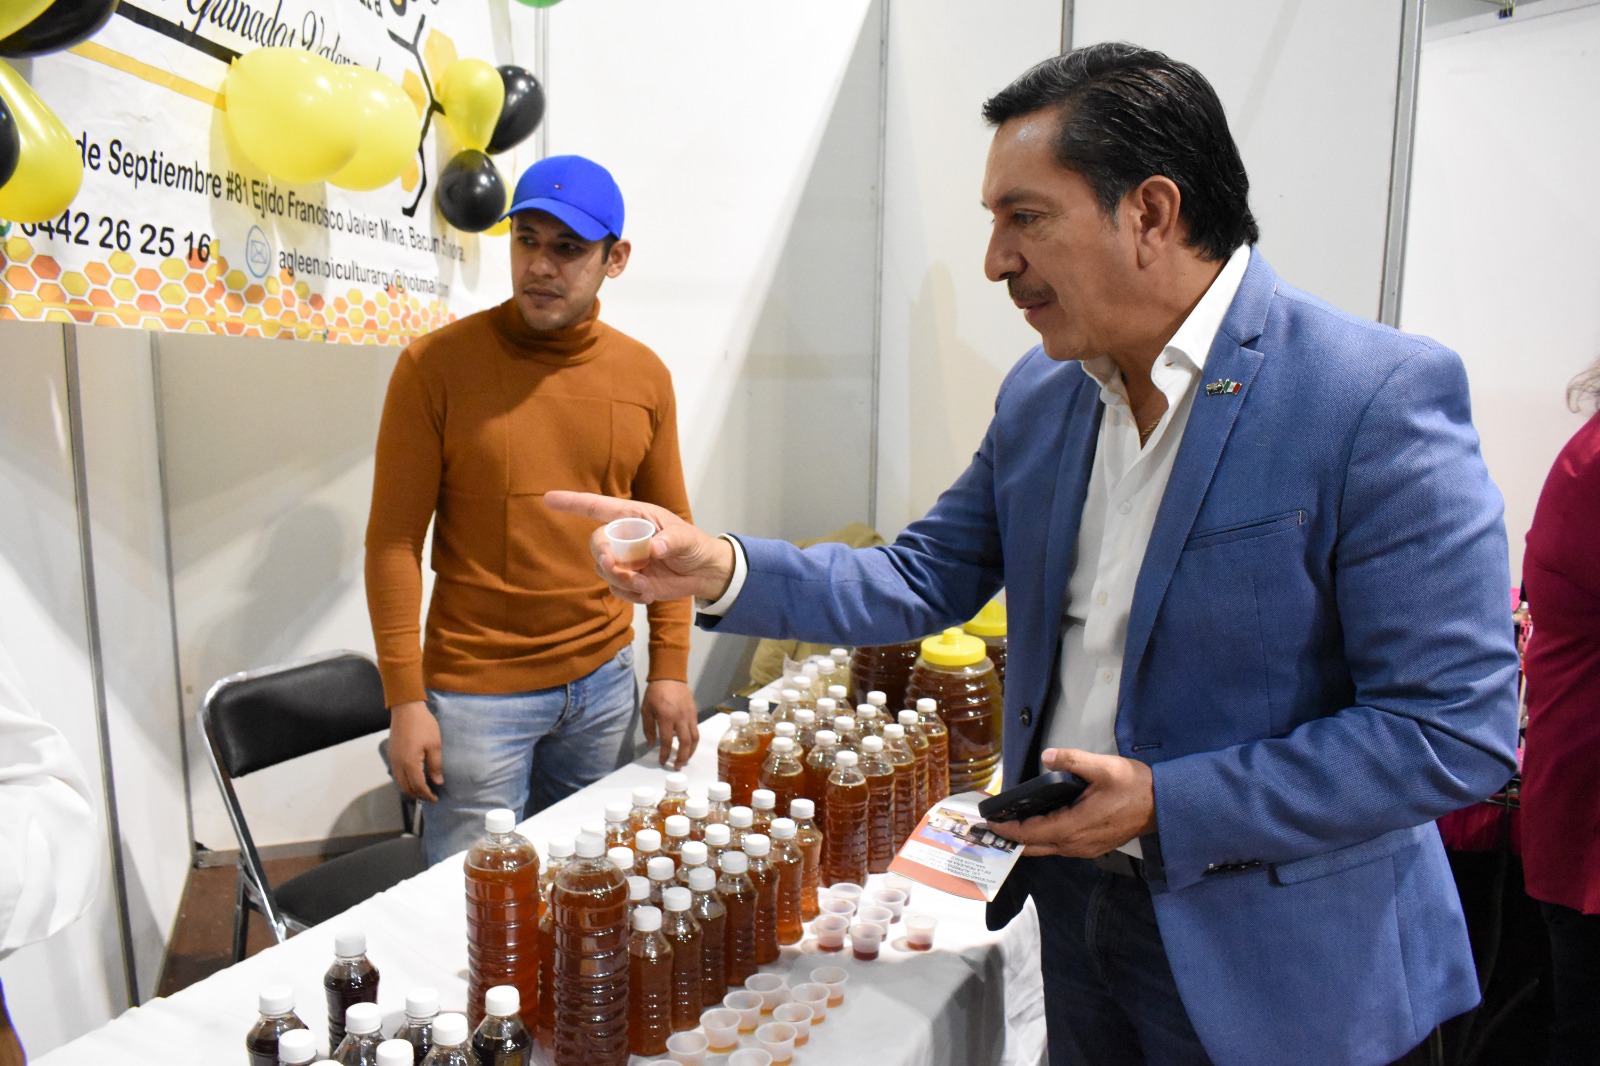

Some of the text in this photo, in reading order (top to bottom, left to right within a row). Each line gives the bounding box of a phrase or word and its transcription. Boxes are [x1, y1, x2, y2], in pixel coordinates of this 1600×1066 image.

[108, 139, 222, 198] Septiembre
[226, 170, 249, 206] #81
[252, 178, 285, 219] Ejido
[287, 191, 344, 231] Francisco
[346, 209, 379, 240] Javier
[98, 216, 131, 252] 26
[140, 224, 175, 257] 25
[184, 231, 211, 263] 16
